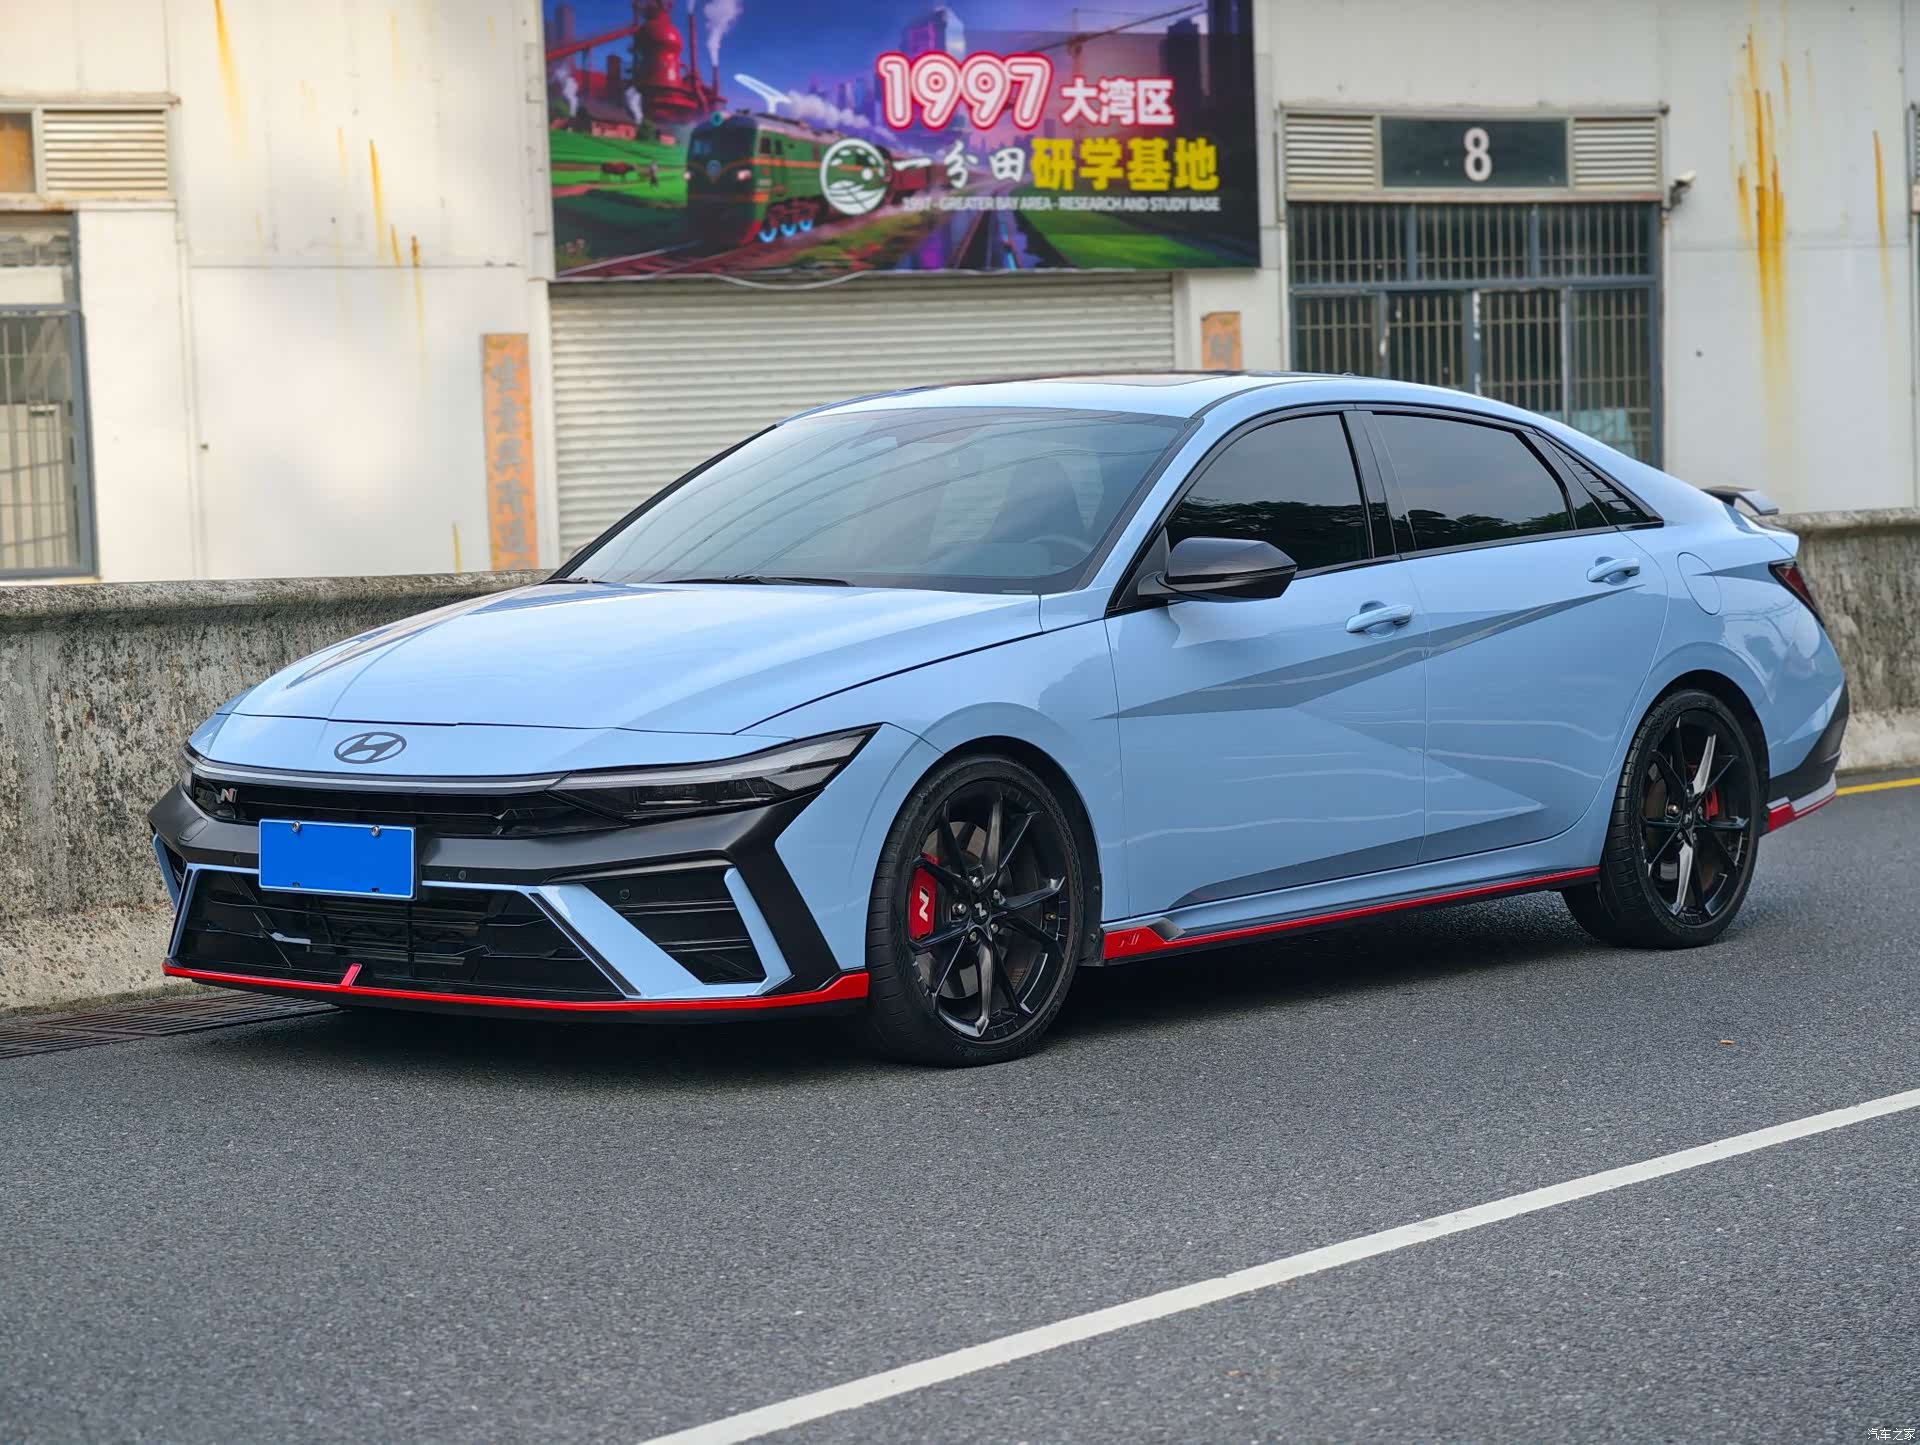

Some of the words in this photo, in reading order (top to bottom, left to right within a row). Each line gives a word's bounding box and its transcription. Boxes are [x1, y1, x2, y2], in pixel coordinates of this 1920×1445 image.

[877, 53, 1052, 130] 1997
[1060, 76, 1176, 126] 大湾区
[1030, 137, 1220, 191] 研学基地
[1463, 127, 1493, 182] 8
[1150, 196, 1188, 211] STUDY
